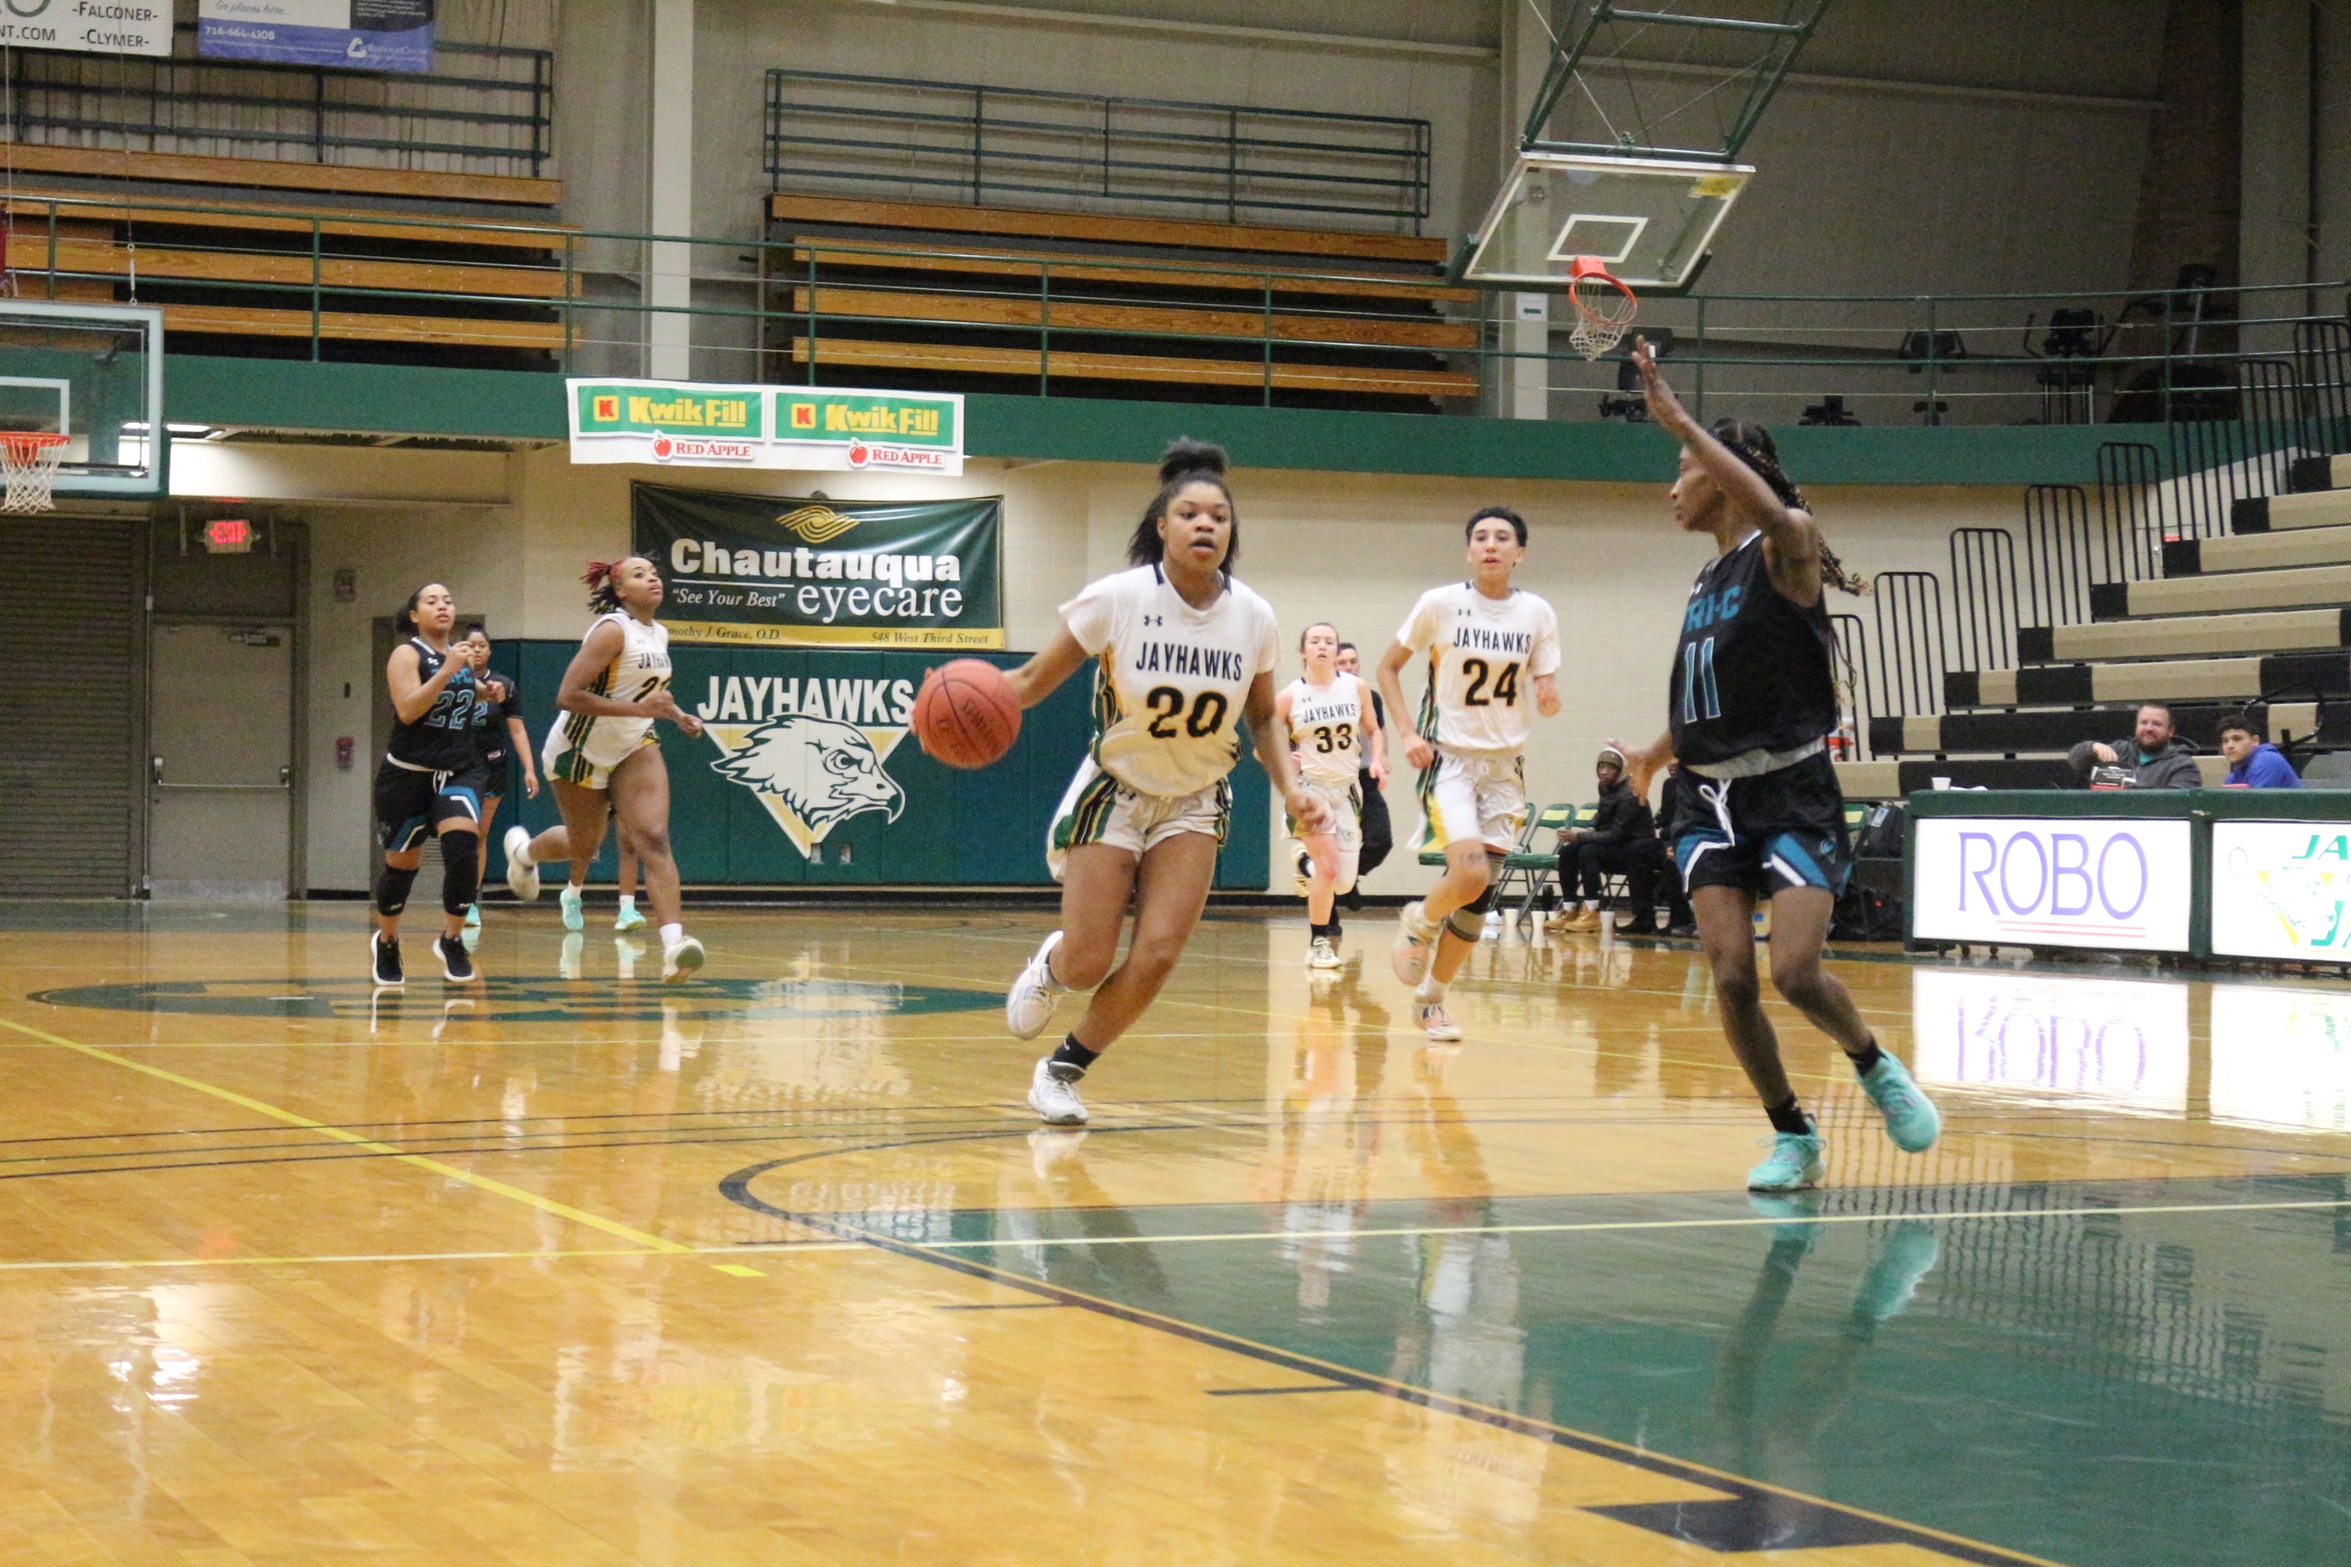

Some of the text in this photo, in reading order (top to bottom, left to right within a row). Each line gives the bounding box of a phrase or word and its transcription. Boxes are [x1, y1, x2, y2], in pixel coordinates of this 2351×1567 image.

[599, 396, 747, 428] K Kwik Fill
[796, 403, 939, 436] K Kwik Fill
[675, 442, 751, 457] RED APPLE
[872, 449, 944, 465] RED APPLE
[213, 521, 246, 544] EXIT
[670, 538, 961, 588] Chautauqua
[707, 590, 743, 606] Your
[797, 584, 964, 623] eyecare
[1685, 585, 1742, 632] RI-C
[756, 628, 782, 640] O.D.
[870, 632, 989, 644] 548 West Third Street
[1453, 627, 1533, 655] JAYHAWKS
[1135, 641, 1243, 682] JAYHAWKS
[1462, 658, 1521, 707] 24
[1684, 636, 1721, 724] 11
[424, 689, 475, 730] 22
[697, 675, 914, 724] JAYHAWKS
[1146, 685, 1228, 738] 20
[1303, 703, 1356, 724] JAYHAWKS
[1313, 723, 1352, 754] 33
[1957, 830, 2148, 921] ROBO
